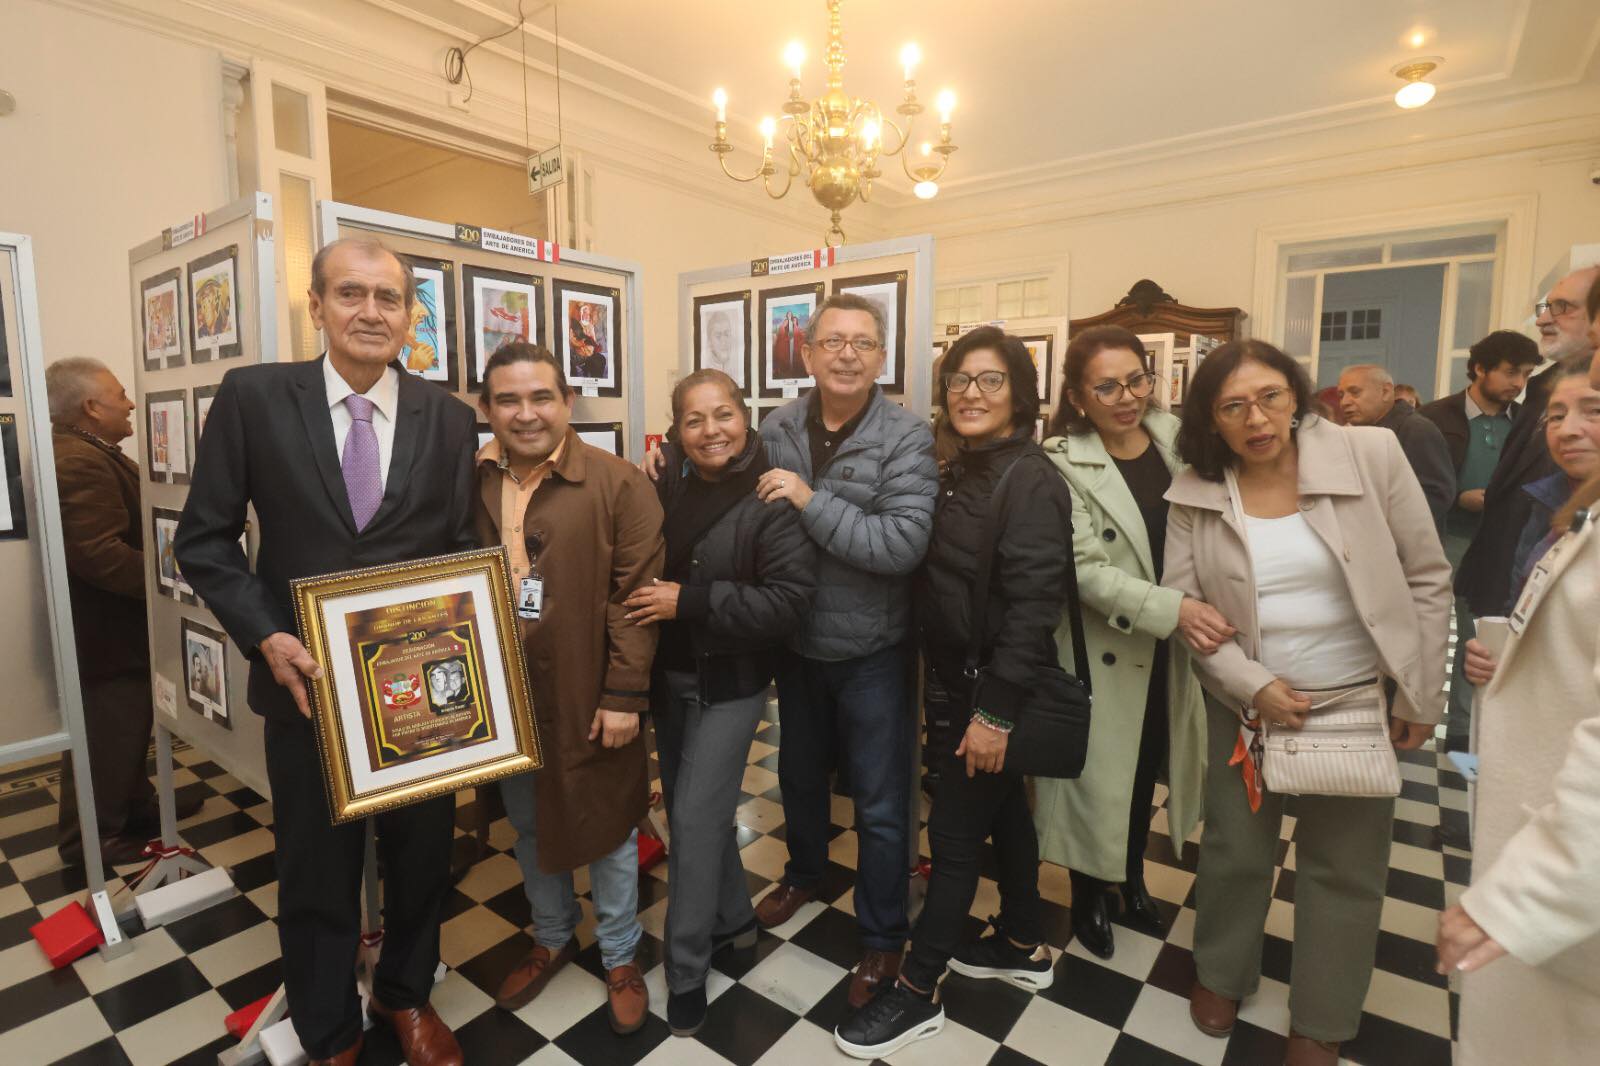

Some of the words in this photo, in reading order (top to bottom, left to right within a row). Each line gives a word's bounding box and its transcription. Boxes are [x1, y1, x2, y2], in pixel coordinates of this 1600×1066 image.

[542, 157, 560, 177] SALIDA
[458, 225, 479, 242] 200
[483, 231, 525, 245] EMBAJADORES
[526, 240, 536, 248] DEL
[485, 240, 500, 248] ARTE
[509, 245, 535, 255] AMERICA
[752, 261, 768, 273] 200
[409, 630, 426, 641] 200
[393, 711, 421, 723] ARTISTA
